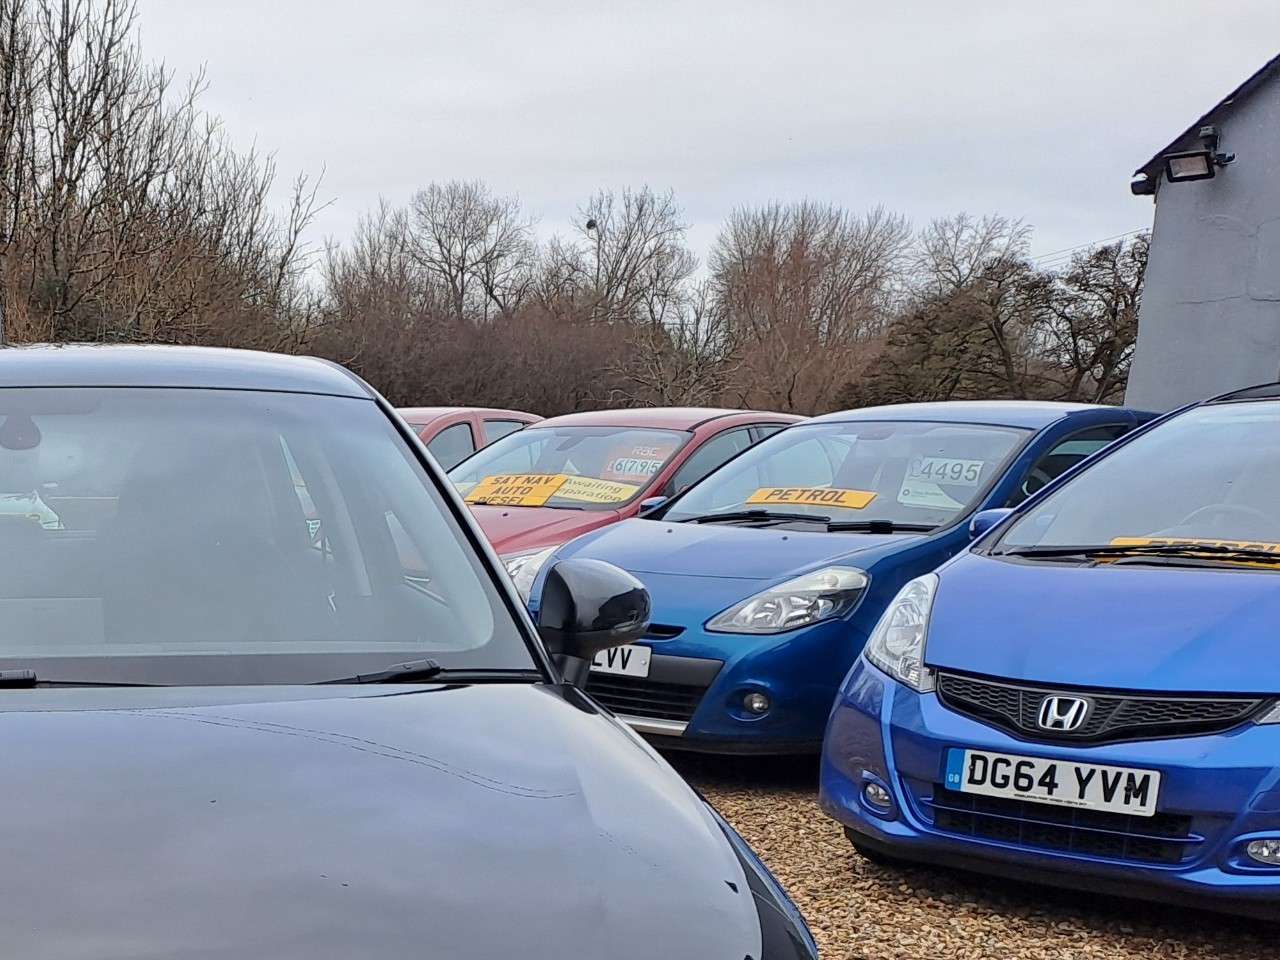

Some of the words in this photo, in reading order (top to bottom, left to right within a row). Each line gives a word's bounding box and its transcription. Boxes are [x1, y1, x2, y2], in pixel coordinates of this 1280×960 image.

[490, 476, 520, 486] SAT
[522, 476, 555, 486] NAV
[492, 486, 533, 496] AUTO
[764, 489, 847, 503] PETROL
[968, 754, 1058, 796] DG64
[1074, 766, 1151, 807] YVM
